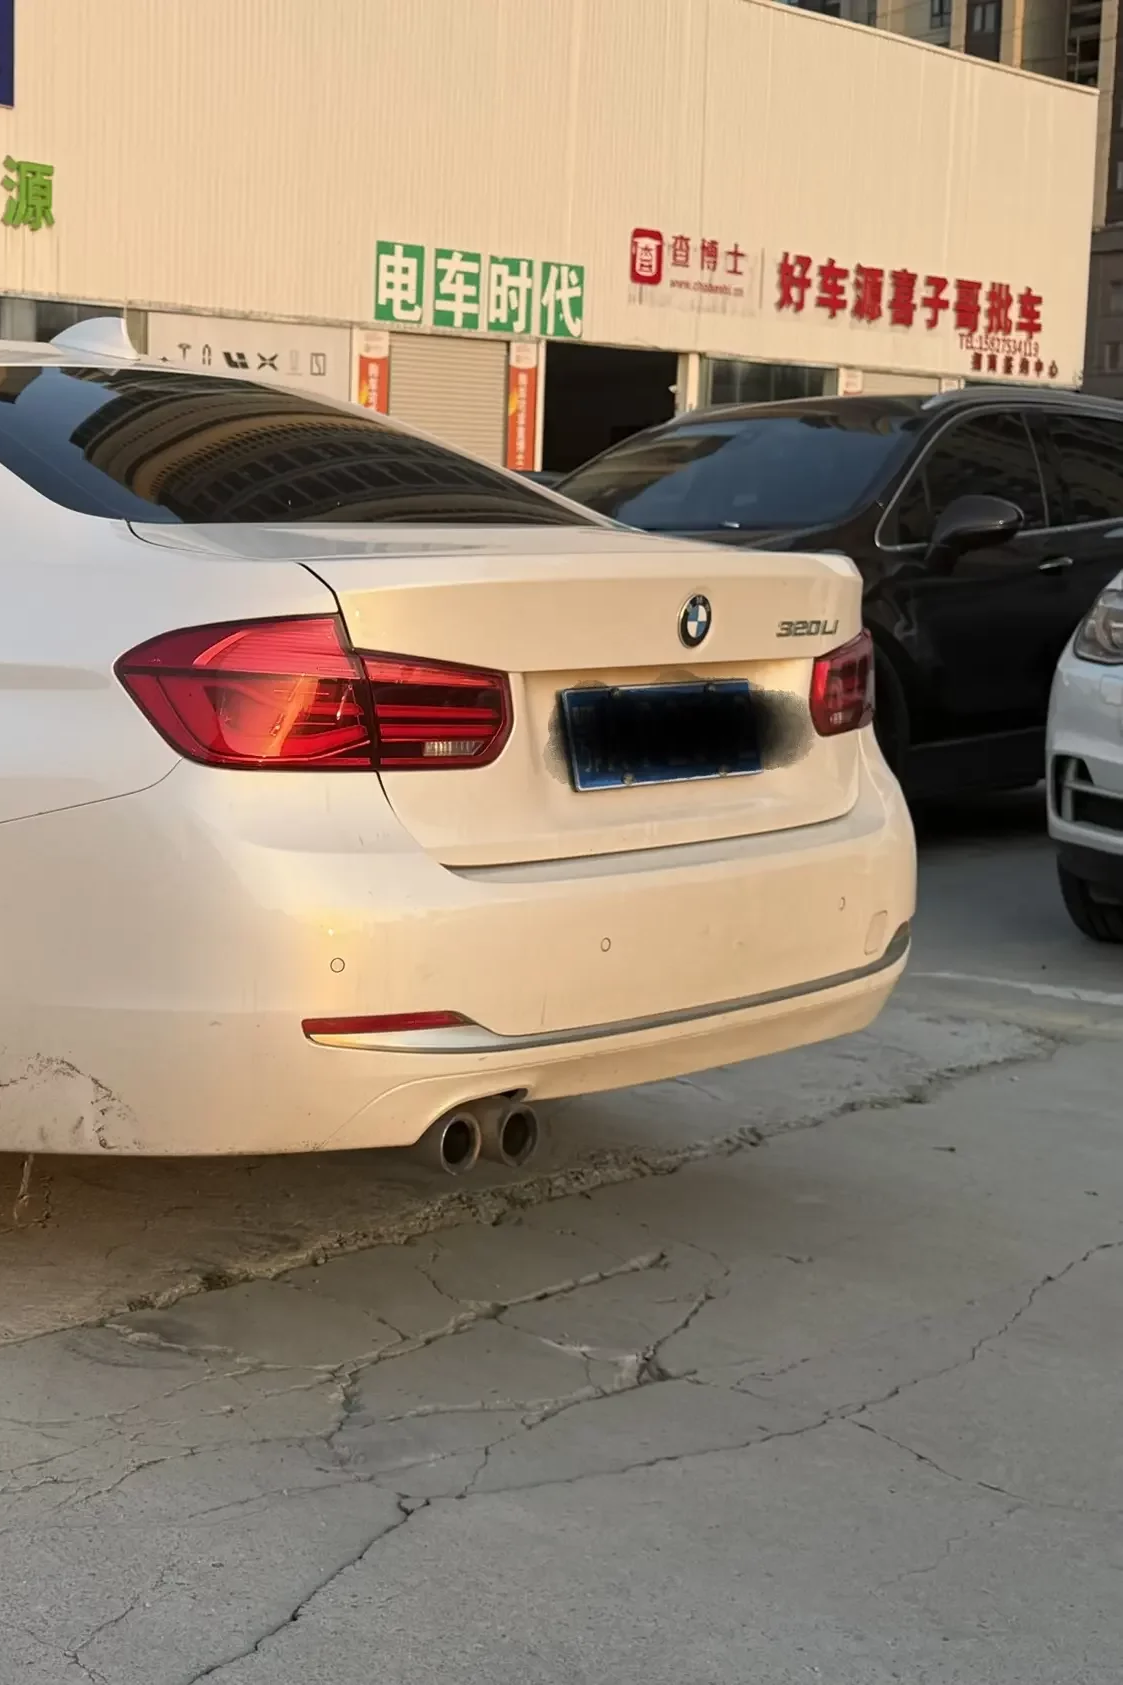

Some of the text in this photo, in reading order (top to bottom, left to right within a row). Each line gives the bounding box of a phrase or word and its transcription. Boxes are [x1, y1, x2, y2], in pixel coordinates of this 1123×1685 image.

[671, 235, 746, 275] 查博士
[377, 243, 582, 337] 电车时代
